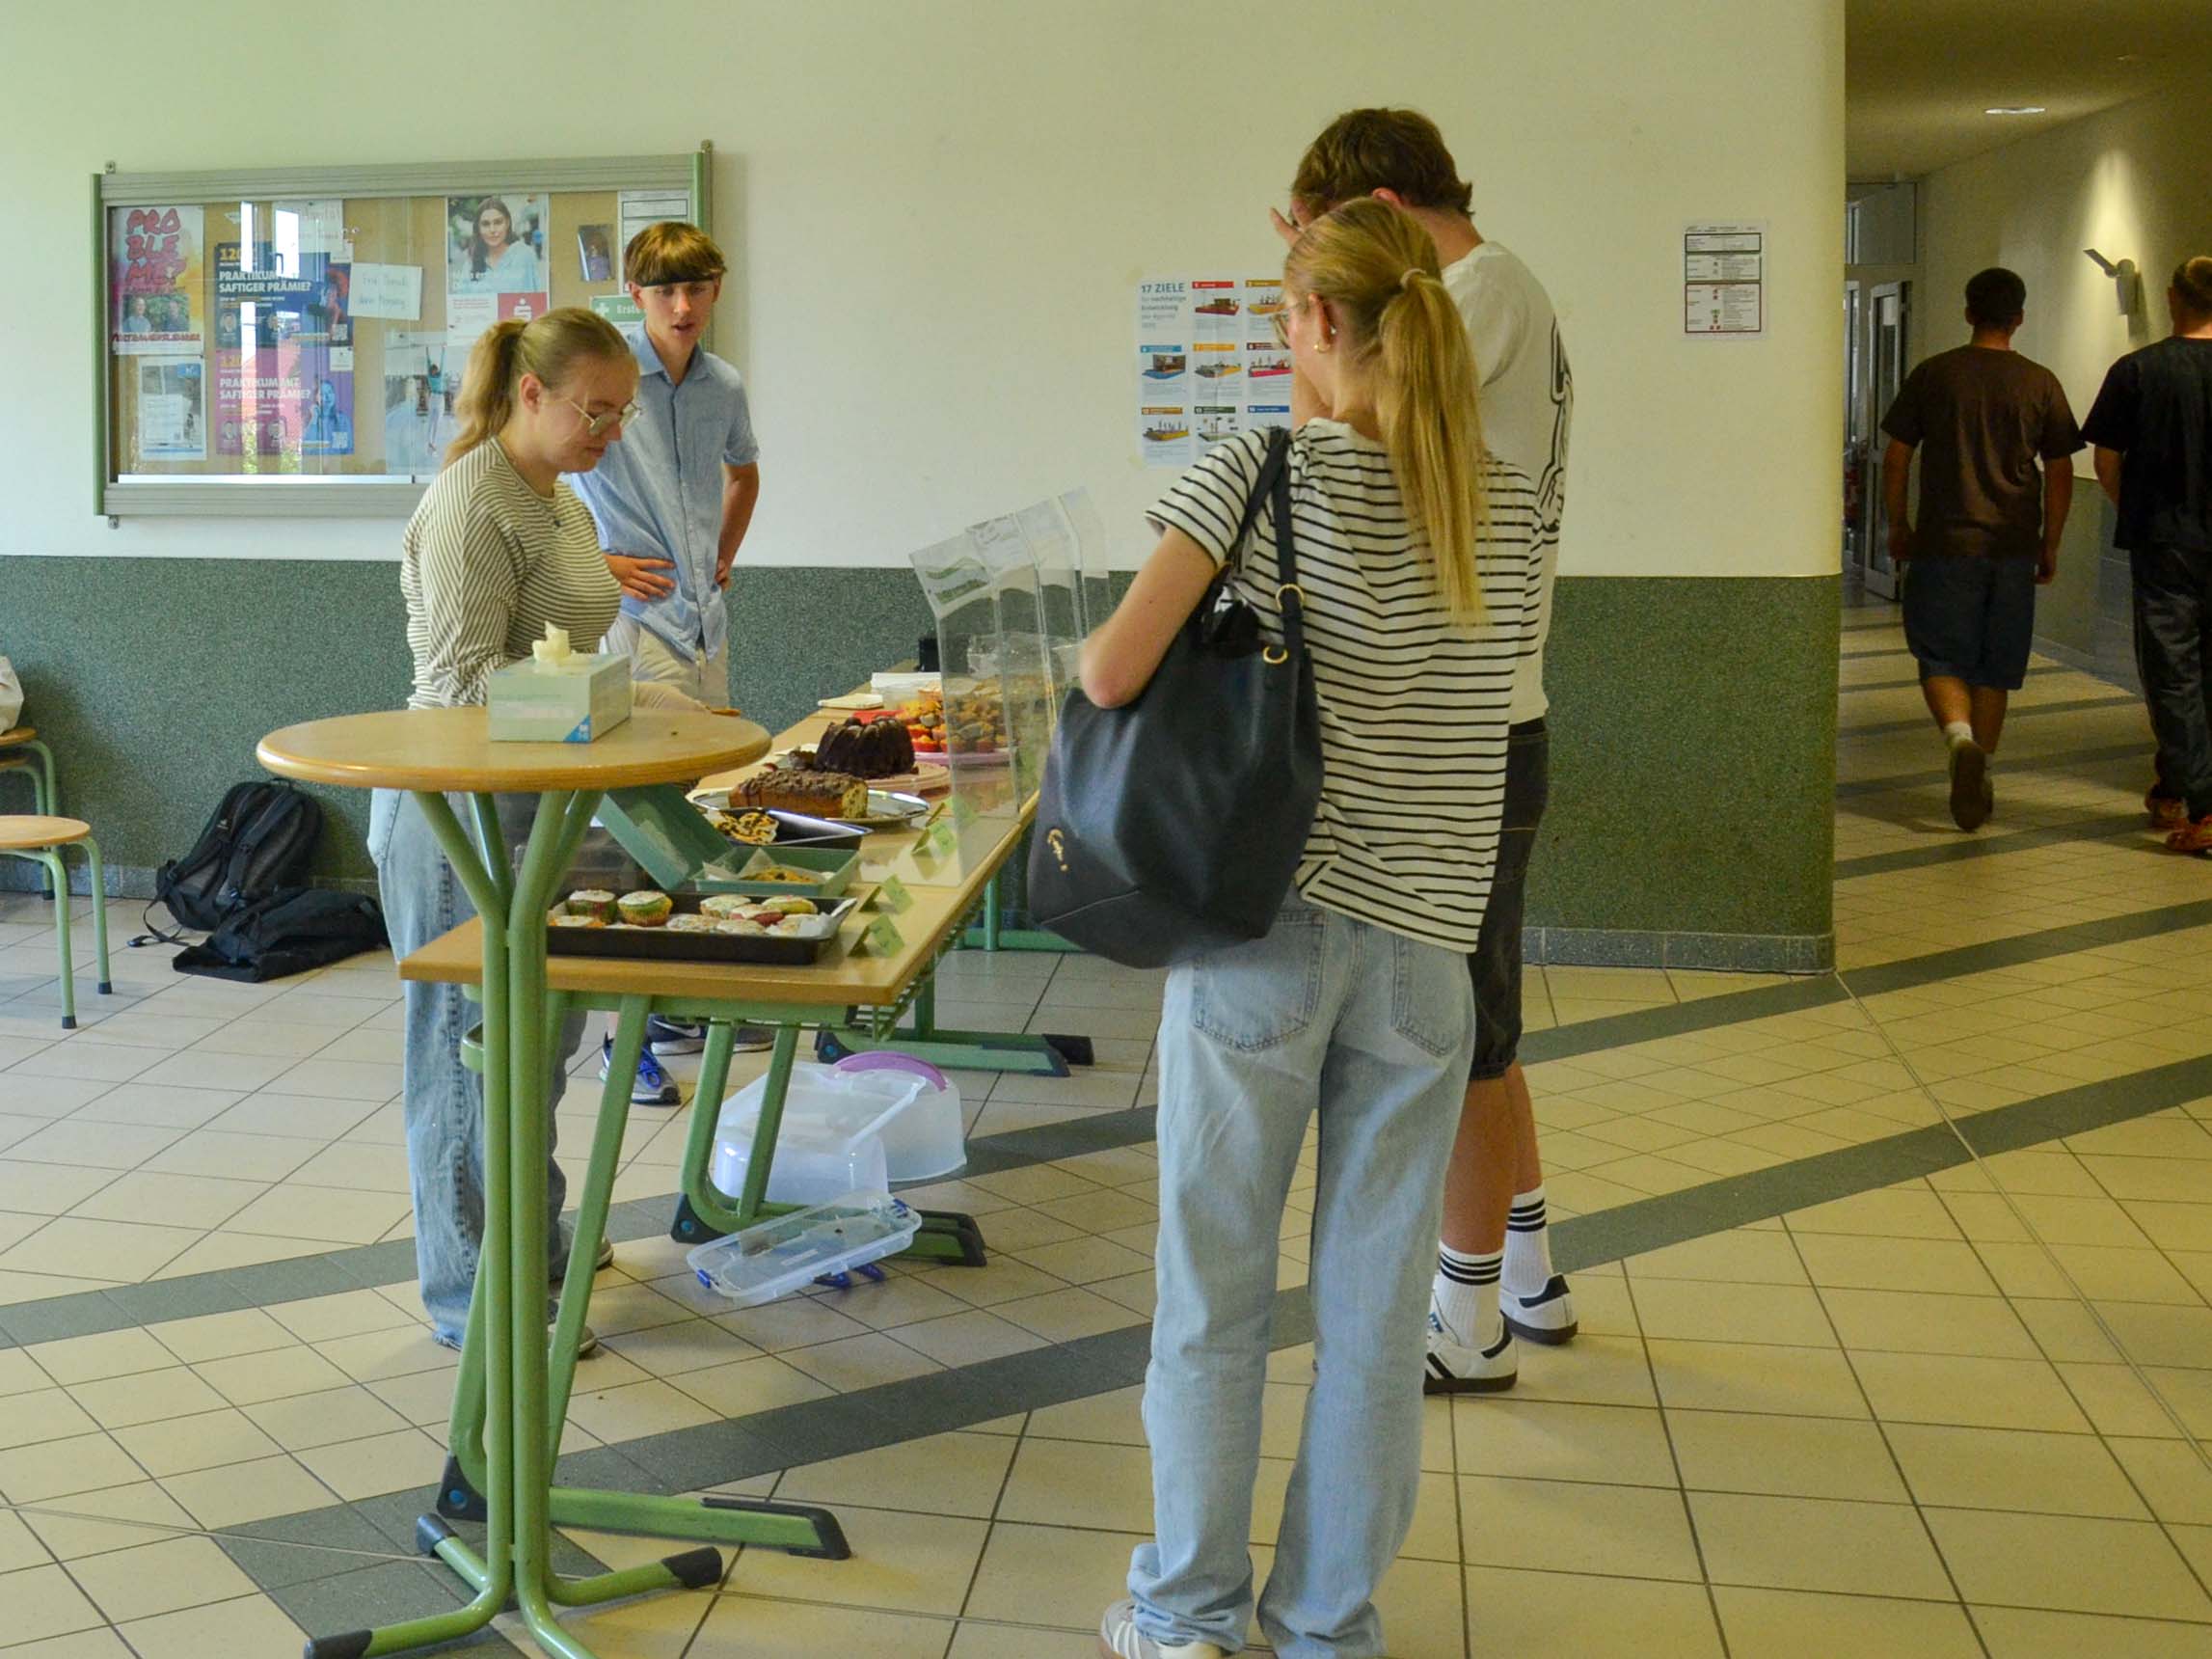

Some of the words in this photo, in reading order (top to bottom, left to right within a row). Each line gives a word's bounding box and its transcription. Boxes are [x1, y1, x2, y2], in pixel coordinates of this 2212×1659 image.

[219, 282, 266, 293] SAFTIGER
[266, 281, 311, 292] PRÄMIE?
[1142, 285, 1152, 293] 17
[1154, 283, 1185, 293] ZIELE
